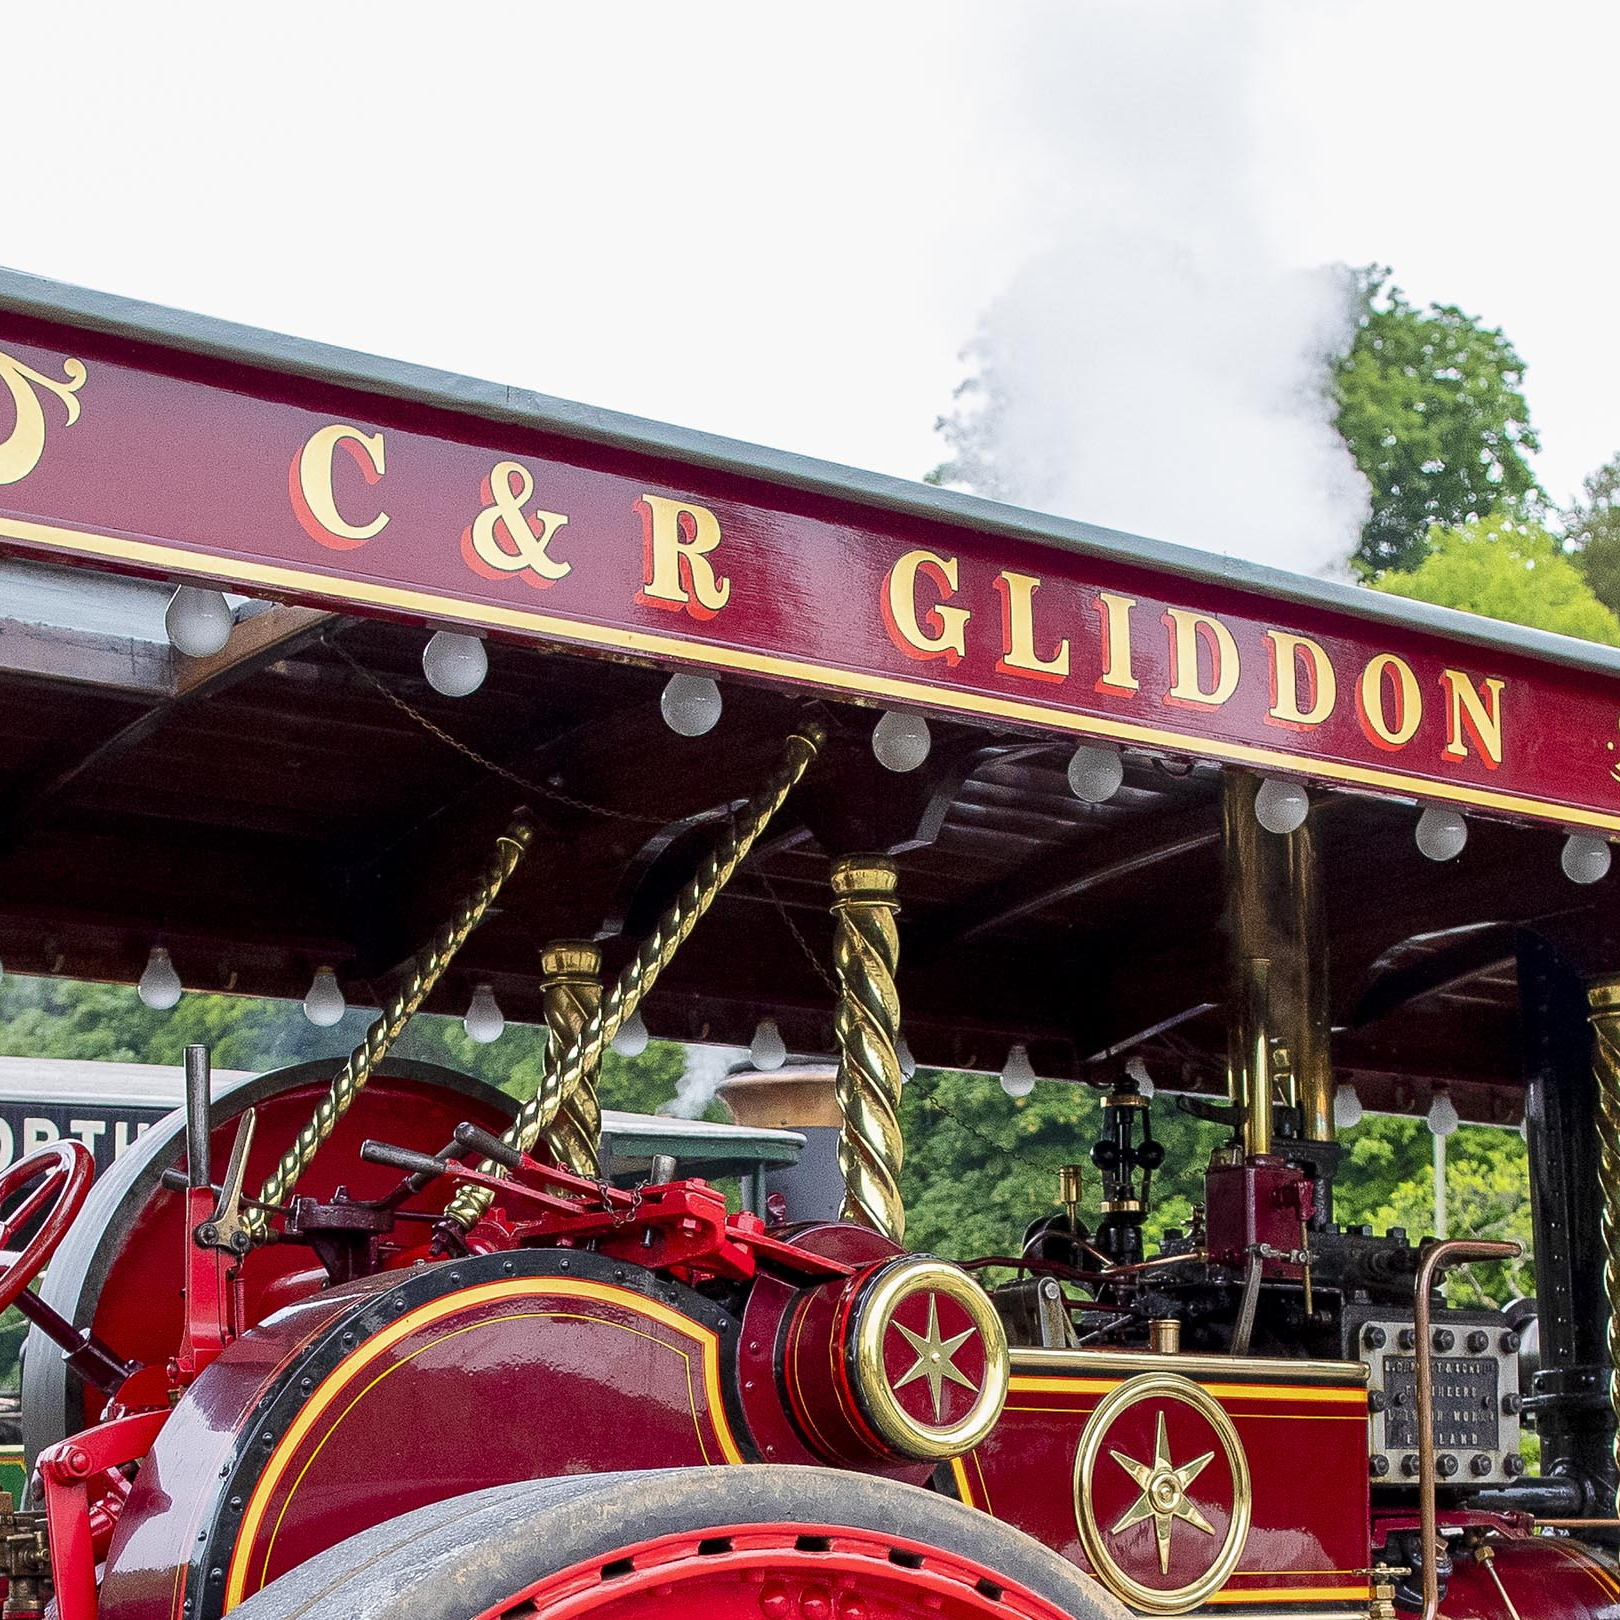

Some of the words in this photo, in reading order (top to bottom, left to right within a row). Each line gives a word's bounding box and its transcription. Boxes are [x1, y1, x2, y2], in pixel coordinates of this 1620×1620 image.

[289, 425, 390, 550] C
[460, 461, 572, 589] &
[633, 493, 730, 620] R
[880, 550, 1506, 770] GLIDDON
